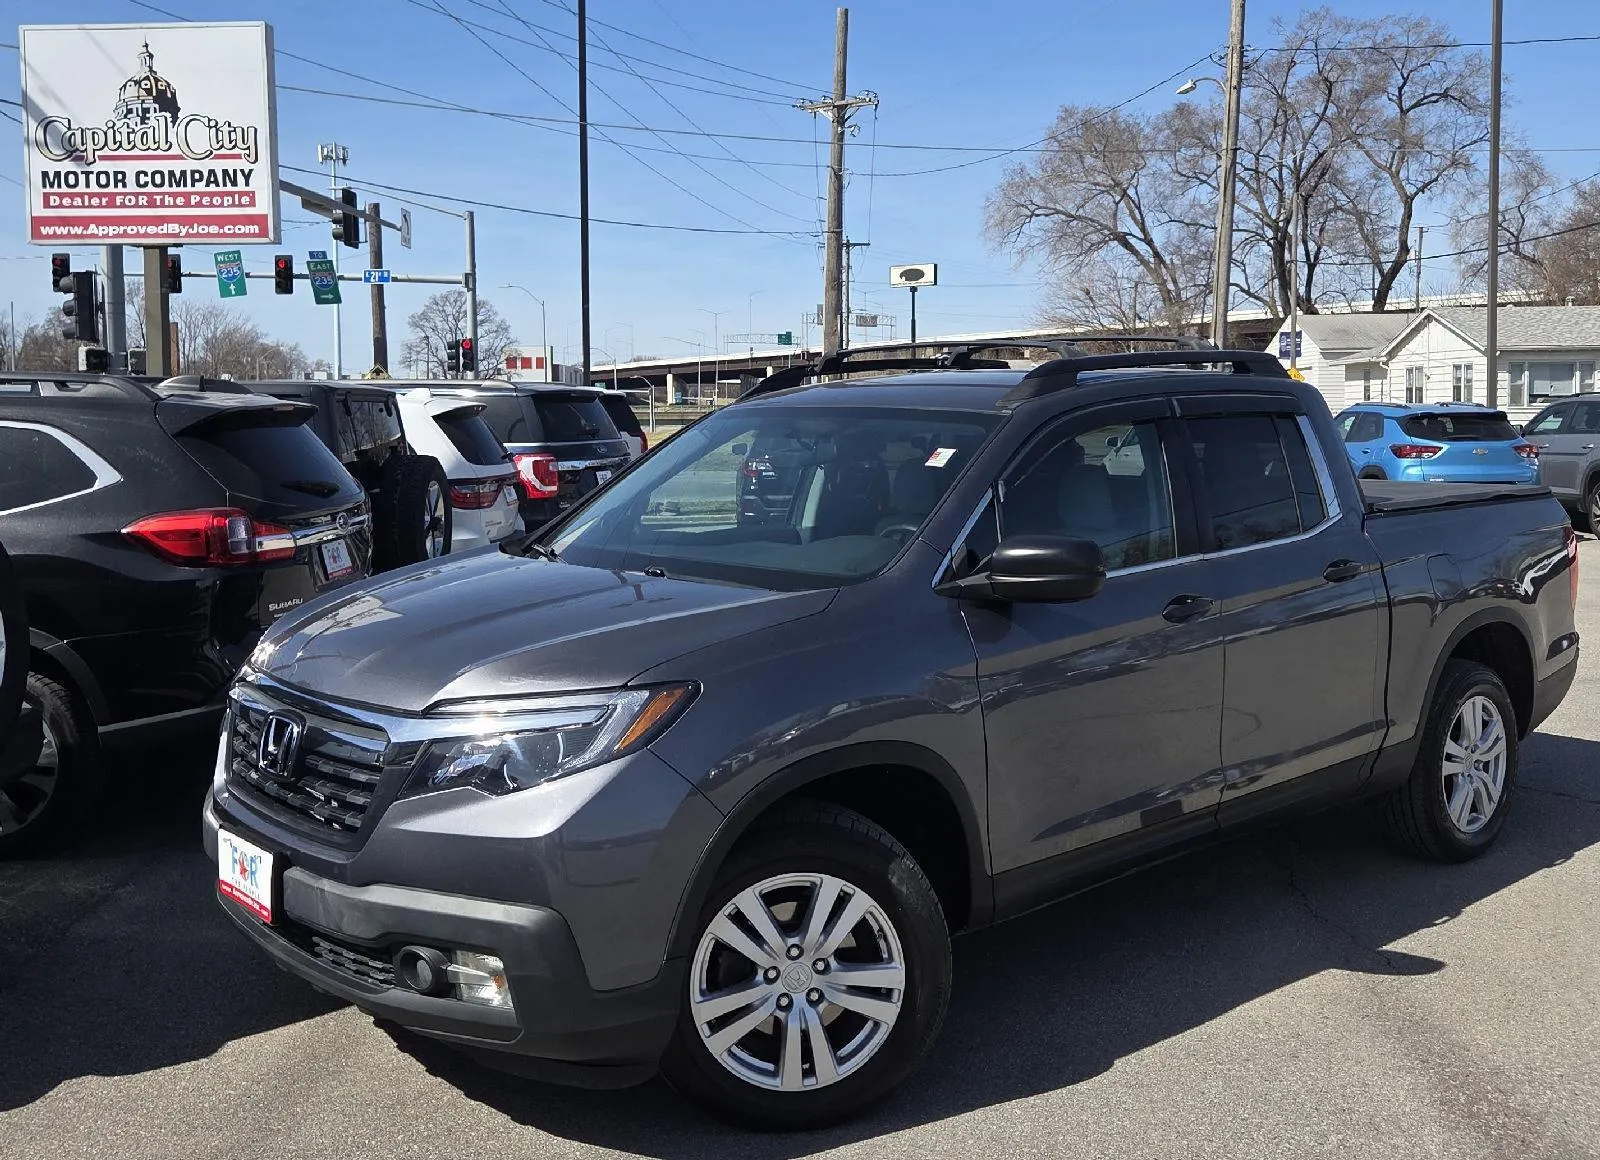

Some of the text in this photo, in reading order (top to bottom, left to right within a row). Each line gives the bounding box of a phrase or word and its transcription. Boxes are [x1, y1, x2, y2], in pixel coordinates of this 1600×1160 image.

[35, 113, 258, 165] Capital City
[41, 168, 254, 189] MOTOR COMPANY
[49, 193, 252, 207] Dealer FOR The People
[40, 223, 259, 236] www.ApprovedByJoe.com
[216, 253, 239, 262] WEST
[220, 267, 240, 278] 235
[310, 262, 331, 271] EAST
[269, 598, 303, 611] SUBARU
[231, 845, 260, 889] FOR
